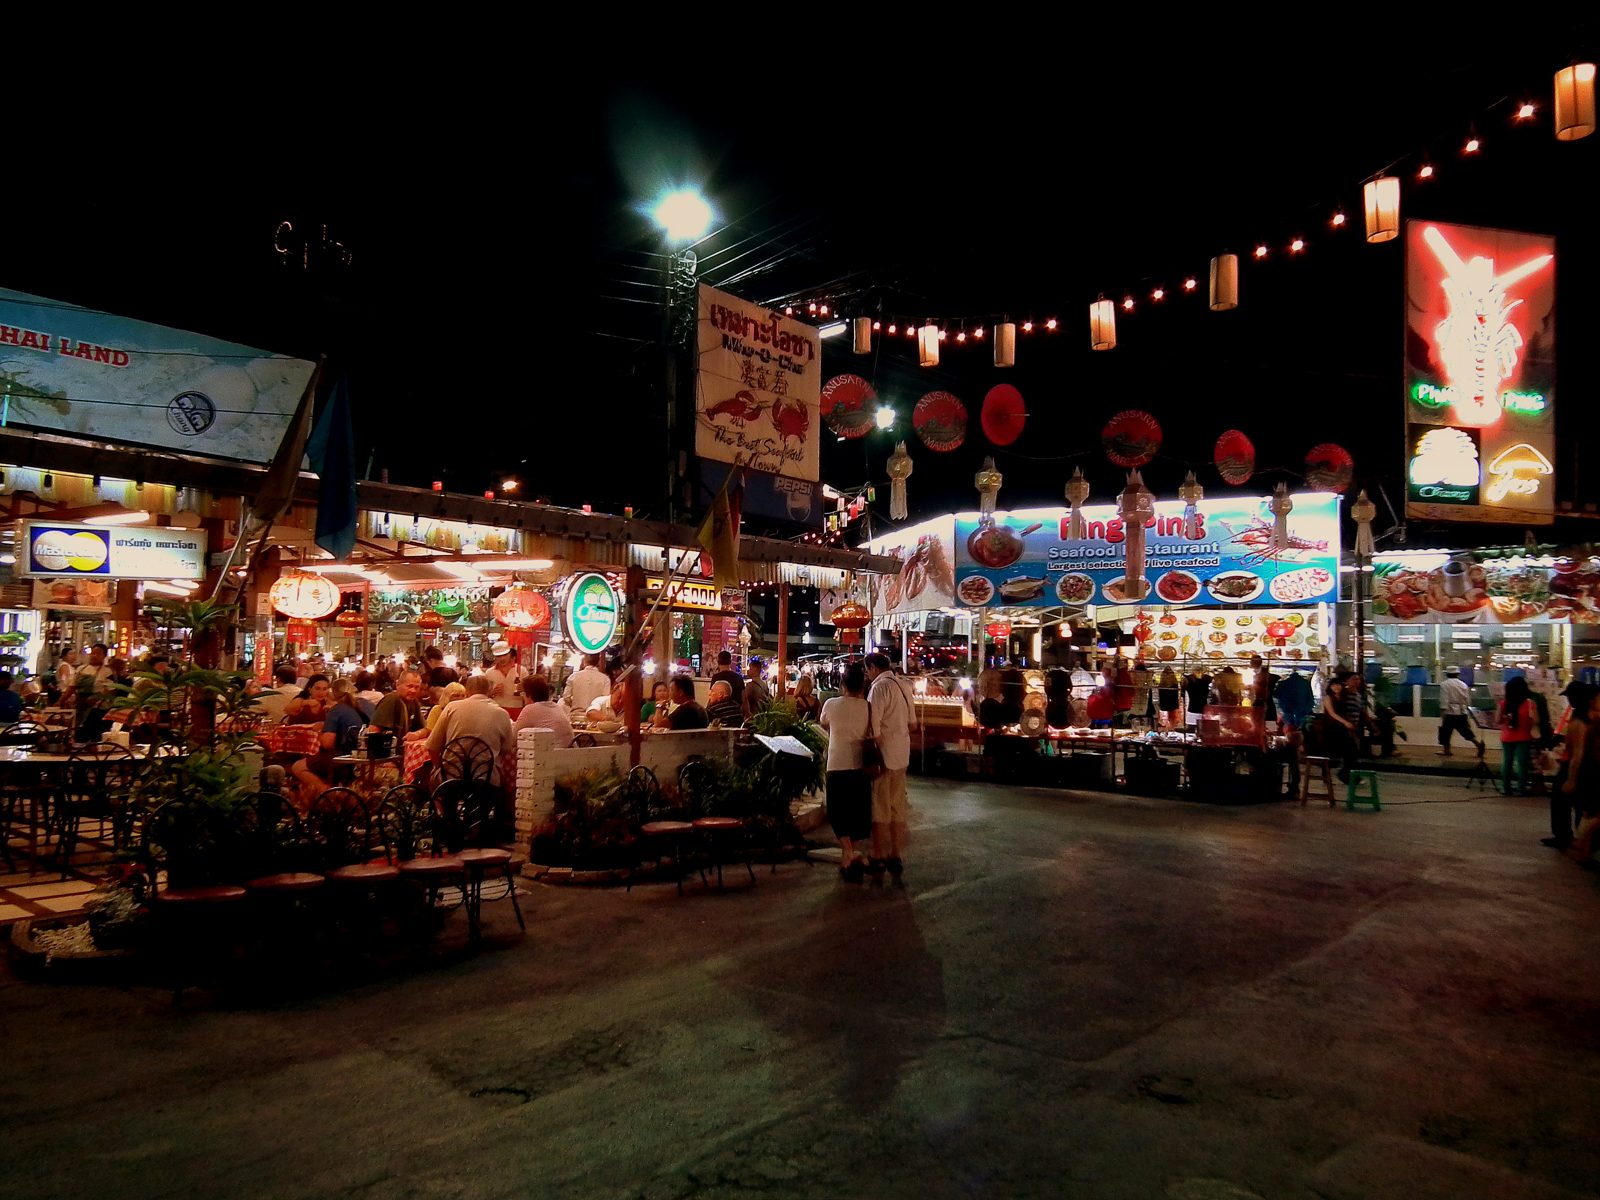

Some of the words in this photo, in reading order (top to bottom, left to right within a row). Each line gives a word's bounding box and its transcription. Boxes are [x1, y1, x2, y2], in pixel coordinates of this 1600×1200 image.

[0, 325, 50, 352] HAI
[60, 338, 129, 366] LAND
[822, 374, 871, 399] ANUSARN
[917, 391, 963, 412] ANUSARN
[713, 425, 735, 446] The
[736, 433, 760, 452] Best
[924, 436, 962, 451] MARKET
[775, 477, 813, 496] PEPSI
[1048, 545, 1116, 559] Seafood
[1122, 542, 1219, 556] staurant
[1048, 561, 1086, 570] Largest
[1088, 560, 1128, 569] selecti
[1152, 559, 1171, 567] live
[1174, 557, 1219, 567] seafood
[721, 587, 746, 597] PEPSI
